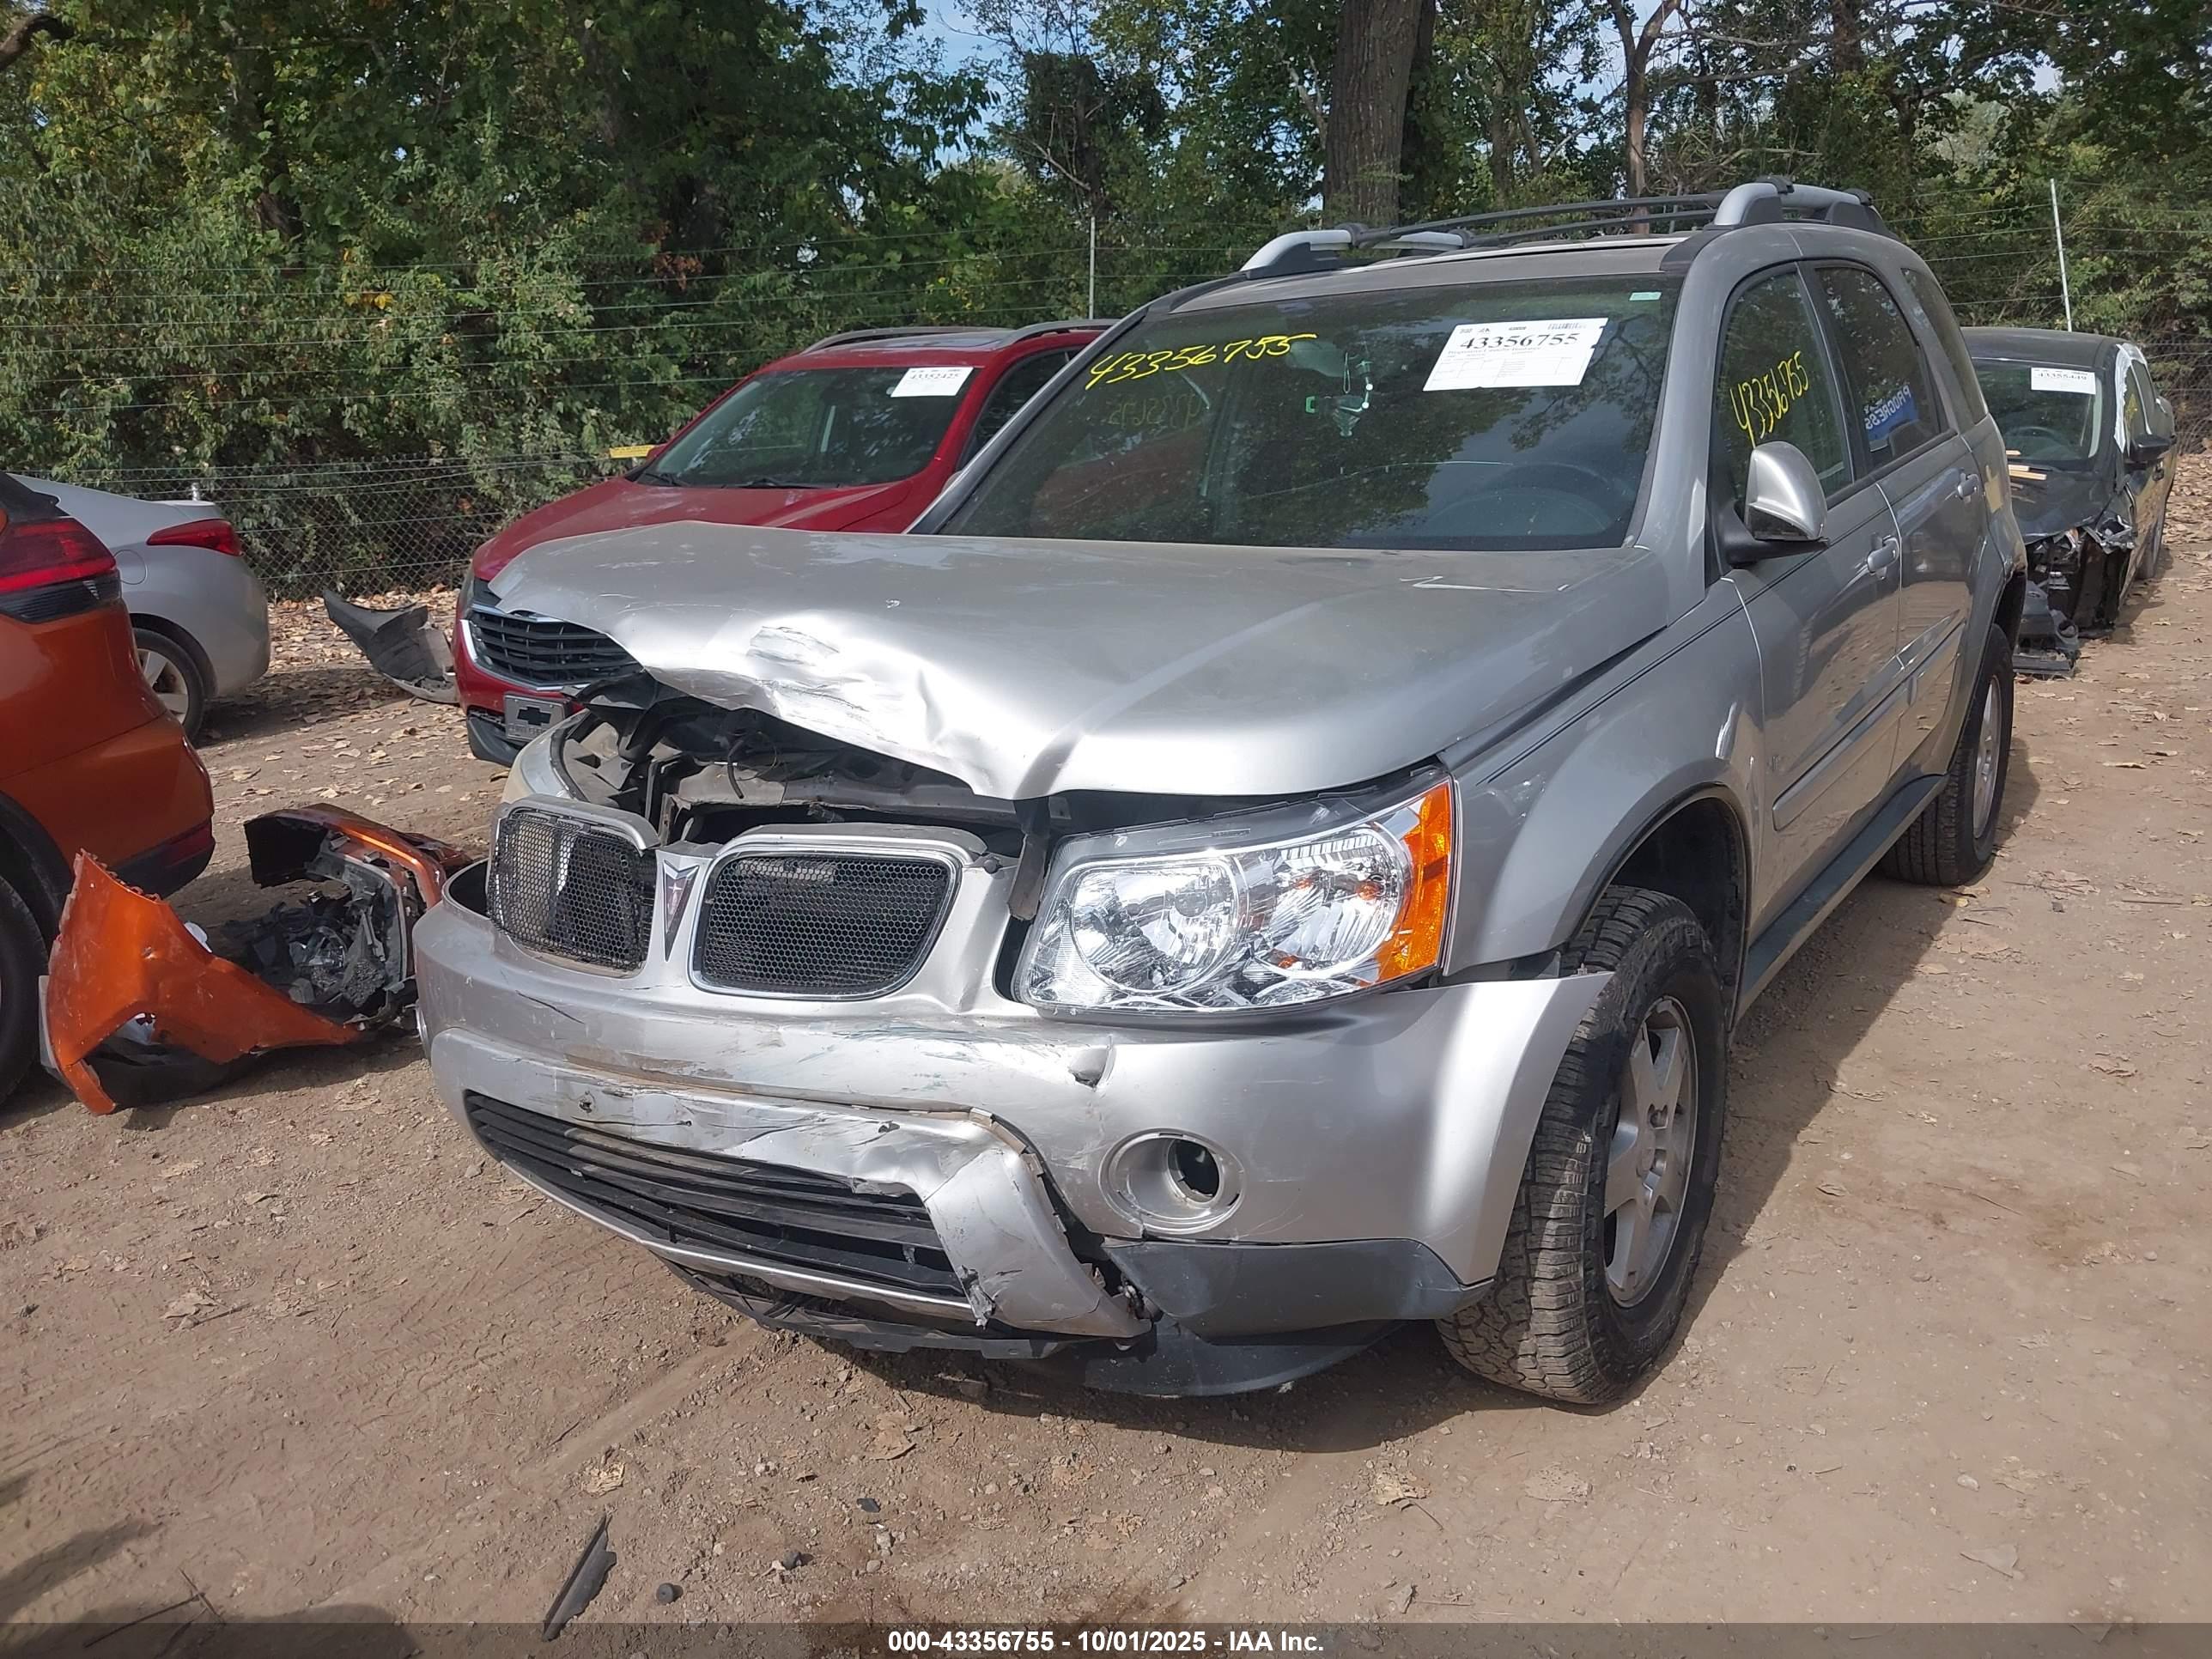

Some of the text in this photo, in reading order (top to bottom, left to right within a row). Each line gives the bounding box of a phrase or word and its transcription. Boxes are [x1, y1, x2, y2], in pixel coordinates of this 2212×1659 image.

[1085, 332, 1318, 391] 43356755
[1460, 332, 1580, 349] 43356755
[1729, 350, 1809, 449] 43356755
